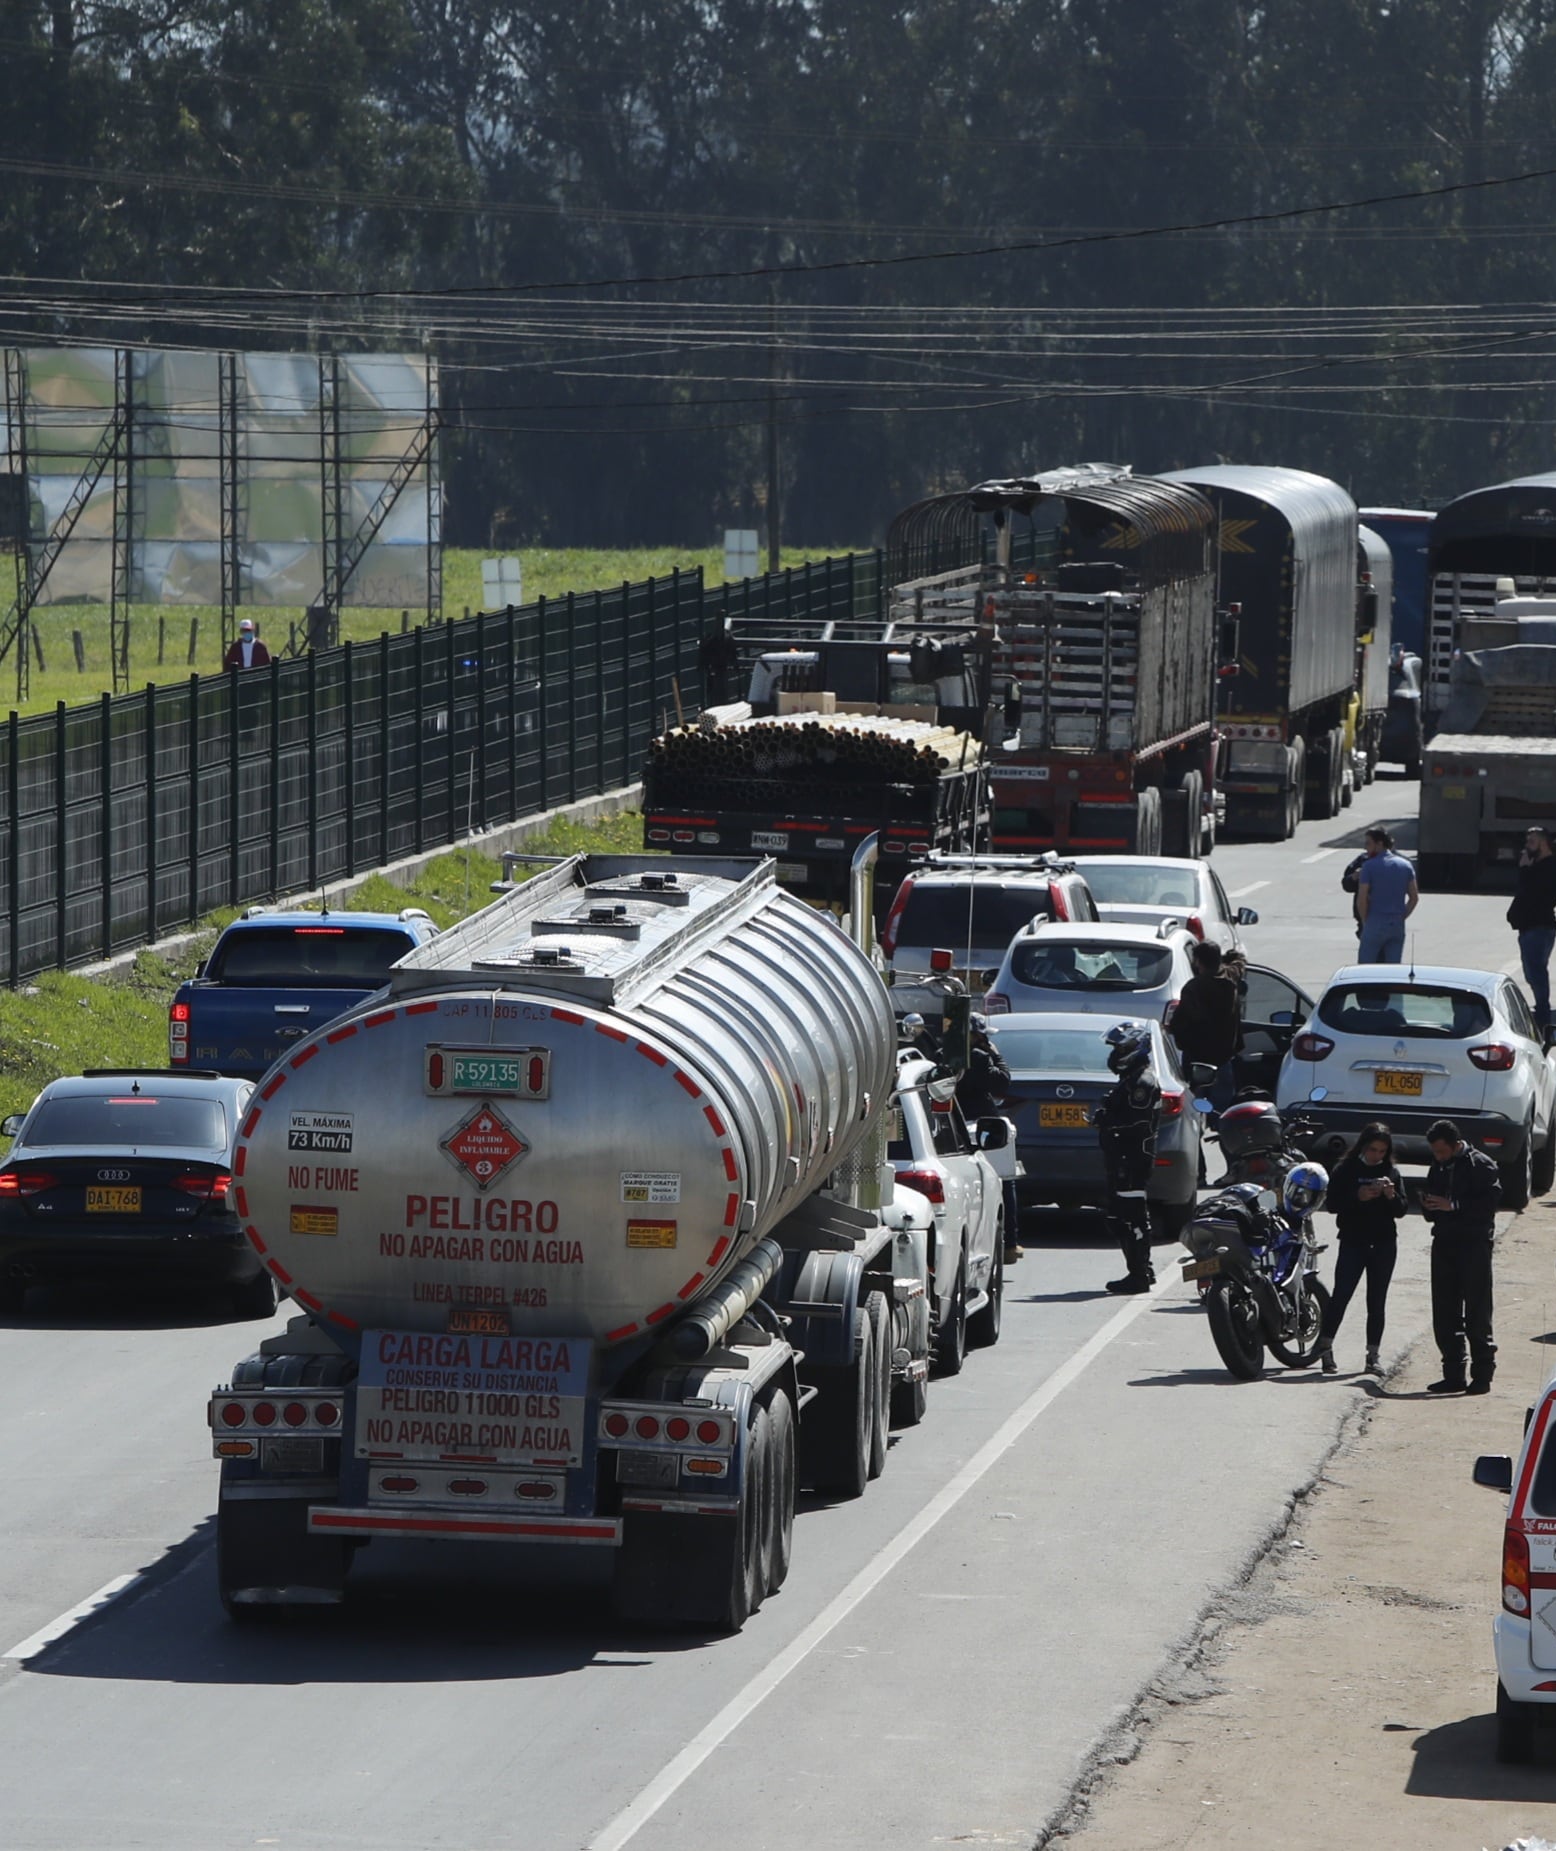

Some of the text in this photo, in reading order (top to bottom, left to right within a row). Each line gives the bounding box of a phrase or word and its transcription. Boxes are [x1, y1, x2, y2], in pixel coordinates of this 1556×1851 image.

[292, 1116, 352, 1129] VEL. MÁXIMA
[291, 1132, 351, 1150] 73 Km/h
[460, 1146, 510, 1155] INFLAMABLE
[288, 1166, 359, 1191] NO FUME
[406, 1194, 559, 1234] PELIGRO
[380, 1233, 584, 1264] NO APAGAR CON AGUA
[414, 1282, 547, 1308] LINEA TERPEL #426
[378, 1334, 572, 1373] CARGA LARGA
[386, 1368, 558, 1393] CONSERVE SU DISTANCIA
[381, 1388, 560, 1419] PELIGRO 11000 GLS
[367, 1419, 572, 1451] NO APAGAR CON AGUA
